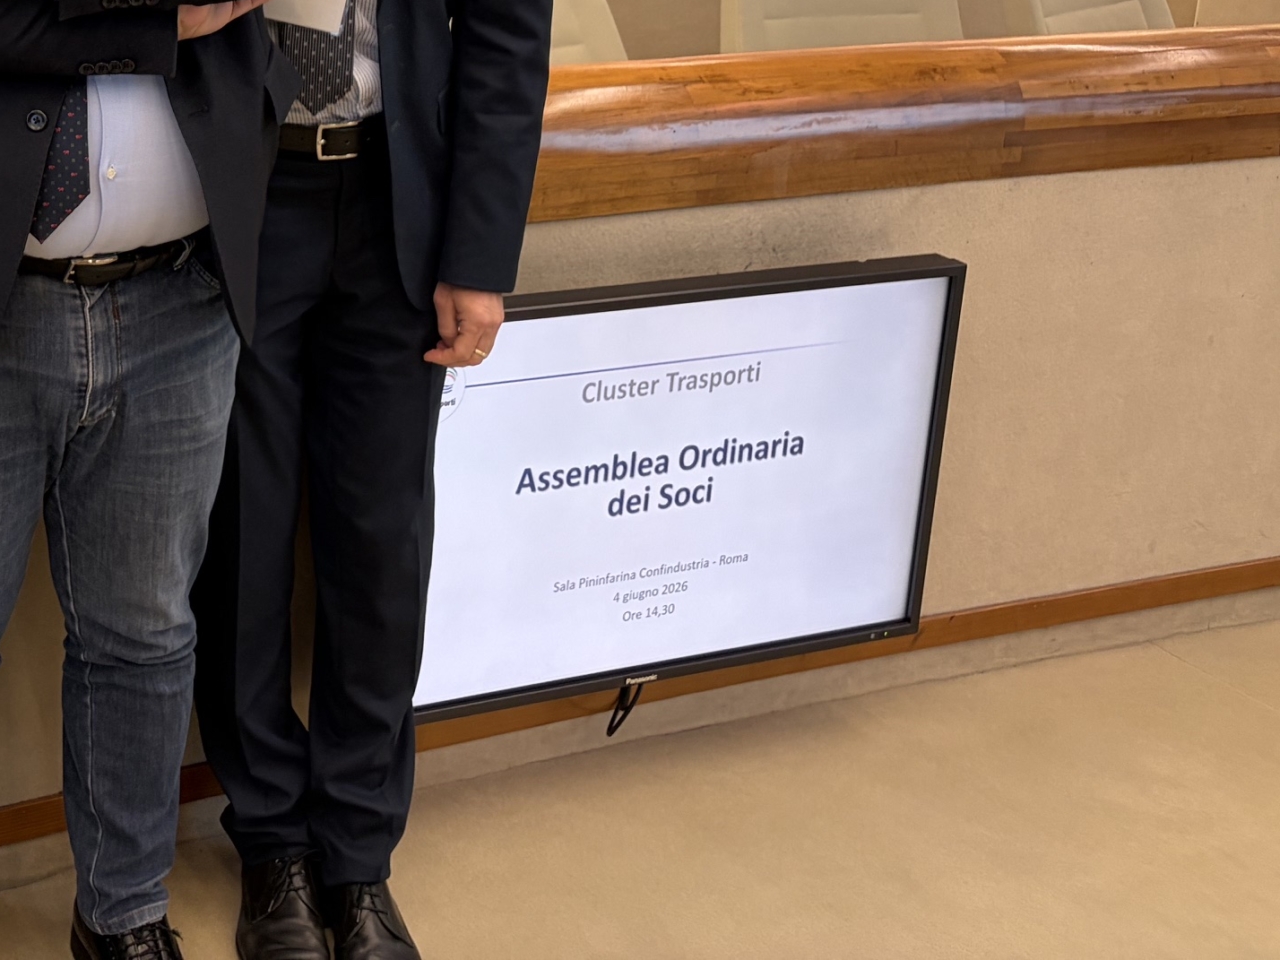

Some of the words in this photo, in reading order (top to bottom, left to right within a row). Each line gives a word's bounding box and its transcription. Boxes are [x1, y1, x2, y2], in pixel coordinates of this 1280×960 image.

[581, 378, 660, 404] Cluster
[666, 360, 762, 394] Trasporti
[514, 450, 670, 496] Assemblea
[678, 430, 805, 472] Ordinaria
[607, 484, 652, 518] dei
[657, 475, 714, 510] Soci
[553, 579, 576, 594] Sala
[579, 571, 637, 589] Pininfarina
[638, 558, 710, 579] Confindustria
[719, 552, 749, 566] Roma
[612, 592, 620, 603] 4
[622, 588, 660, 604] giugno
[661, 580, 689, 596] 2026
[622, 610, 643, 622] Ore
[645, 603, 676, 619] 14,30
